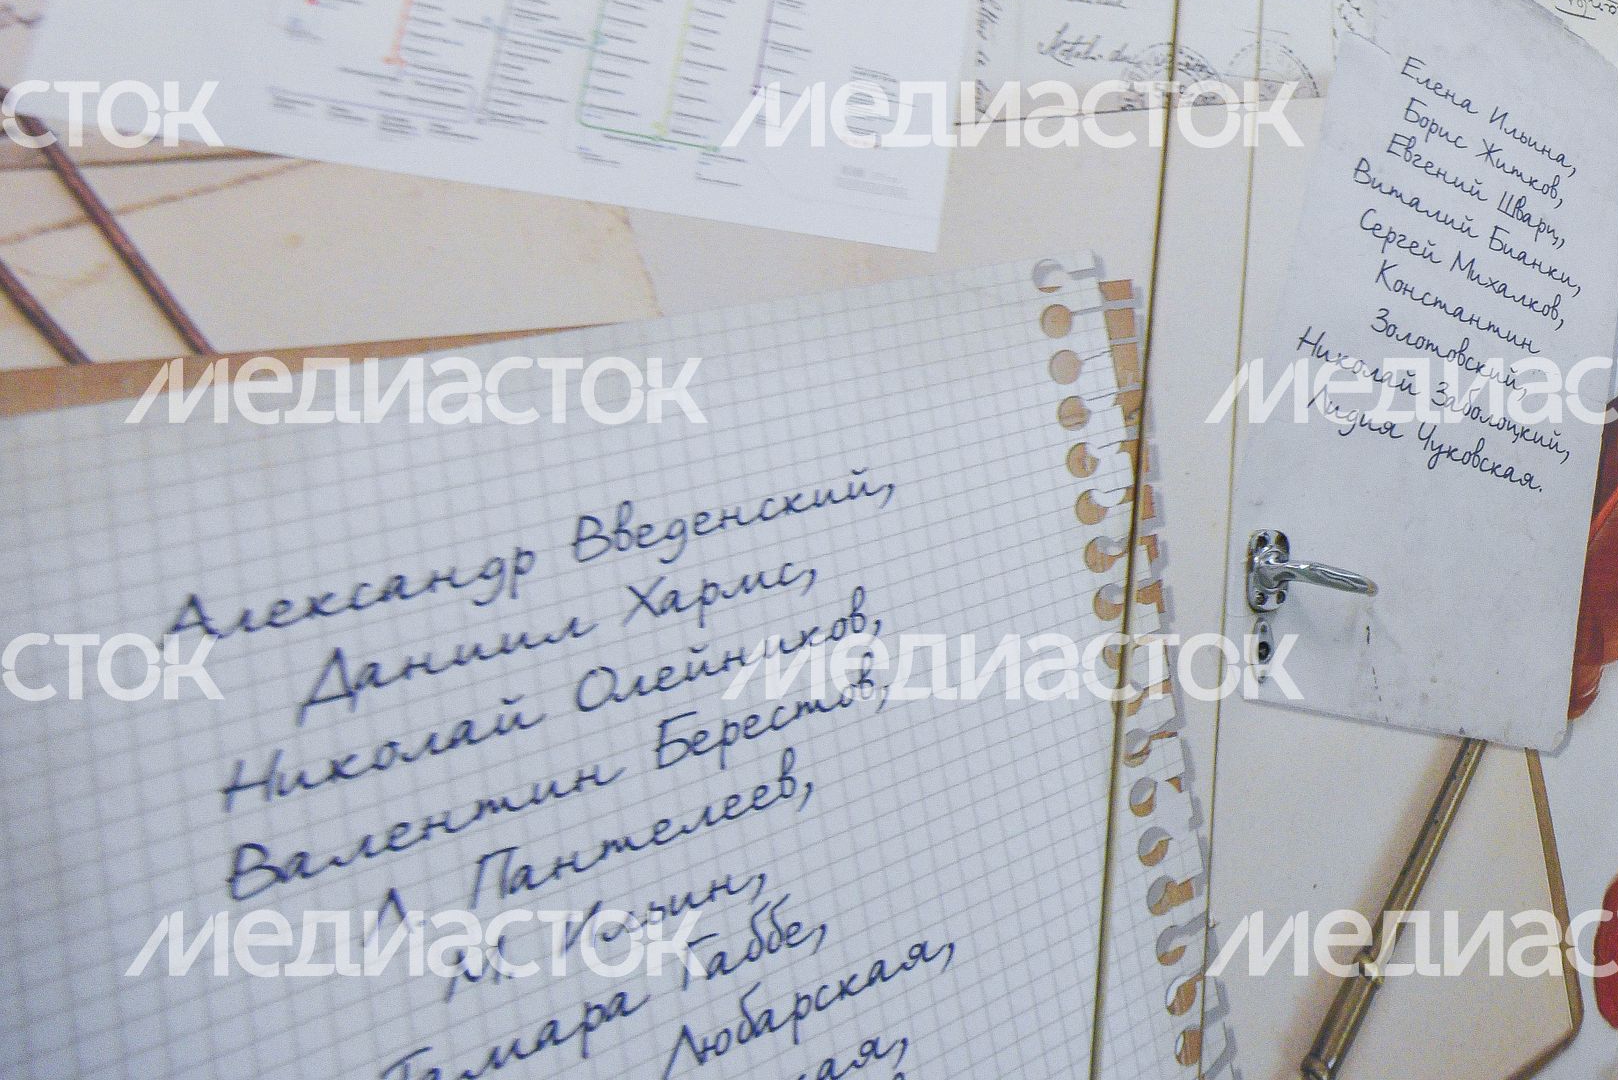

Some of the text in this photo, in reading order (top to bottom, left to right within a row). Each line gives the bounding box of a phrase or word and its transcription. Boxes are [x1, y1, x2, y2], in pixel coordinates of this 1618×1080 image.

[1401, 56, 1479, 115] Елена
[1490, 107, 1577, 177] Ильина,
[1404, 97, 1467, 149] Борис
[1476, 138, 1564, 208] Житков,
[1354, 157, 1582, 297] Виталий Бианки,
[1387, 133, 1565, 250] Евгений Шварц,
[1360, 209, 1565, 329] Сергей Михалков,
[1375, 259, 1541, 355] Константин
[1296, 327, 1571, 464] Николай Заболоцкий,
[1370, 308, 1528, 401] Золотовский,
[1307, 389, 1543, 493] Лидия Чуковская.
[160, 467, 896, 648] Александр Введенский,
[220, 585, 882, 814] Николай Олейников,
[298, 564, 817, 726] Даниил Хармс,
[226, 652, 890, 903] Валентин Берестов,
[471, 747, 811, 911] Пантелеев,
[561, 873, 767, 960] Ильин,
[681, 893, 827, 991] Габбе,
[663, 940, 955, 1080] Любарская,
